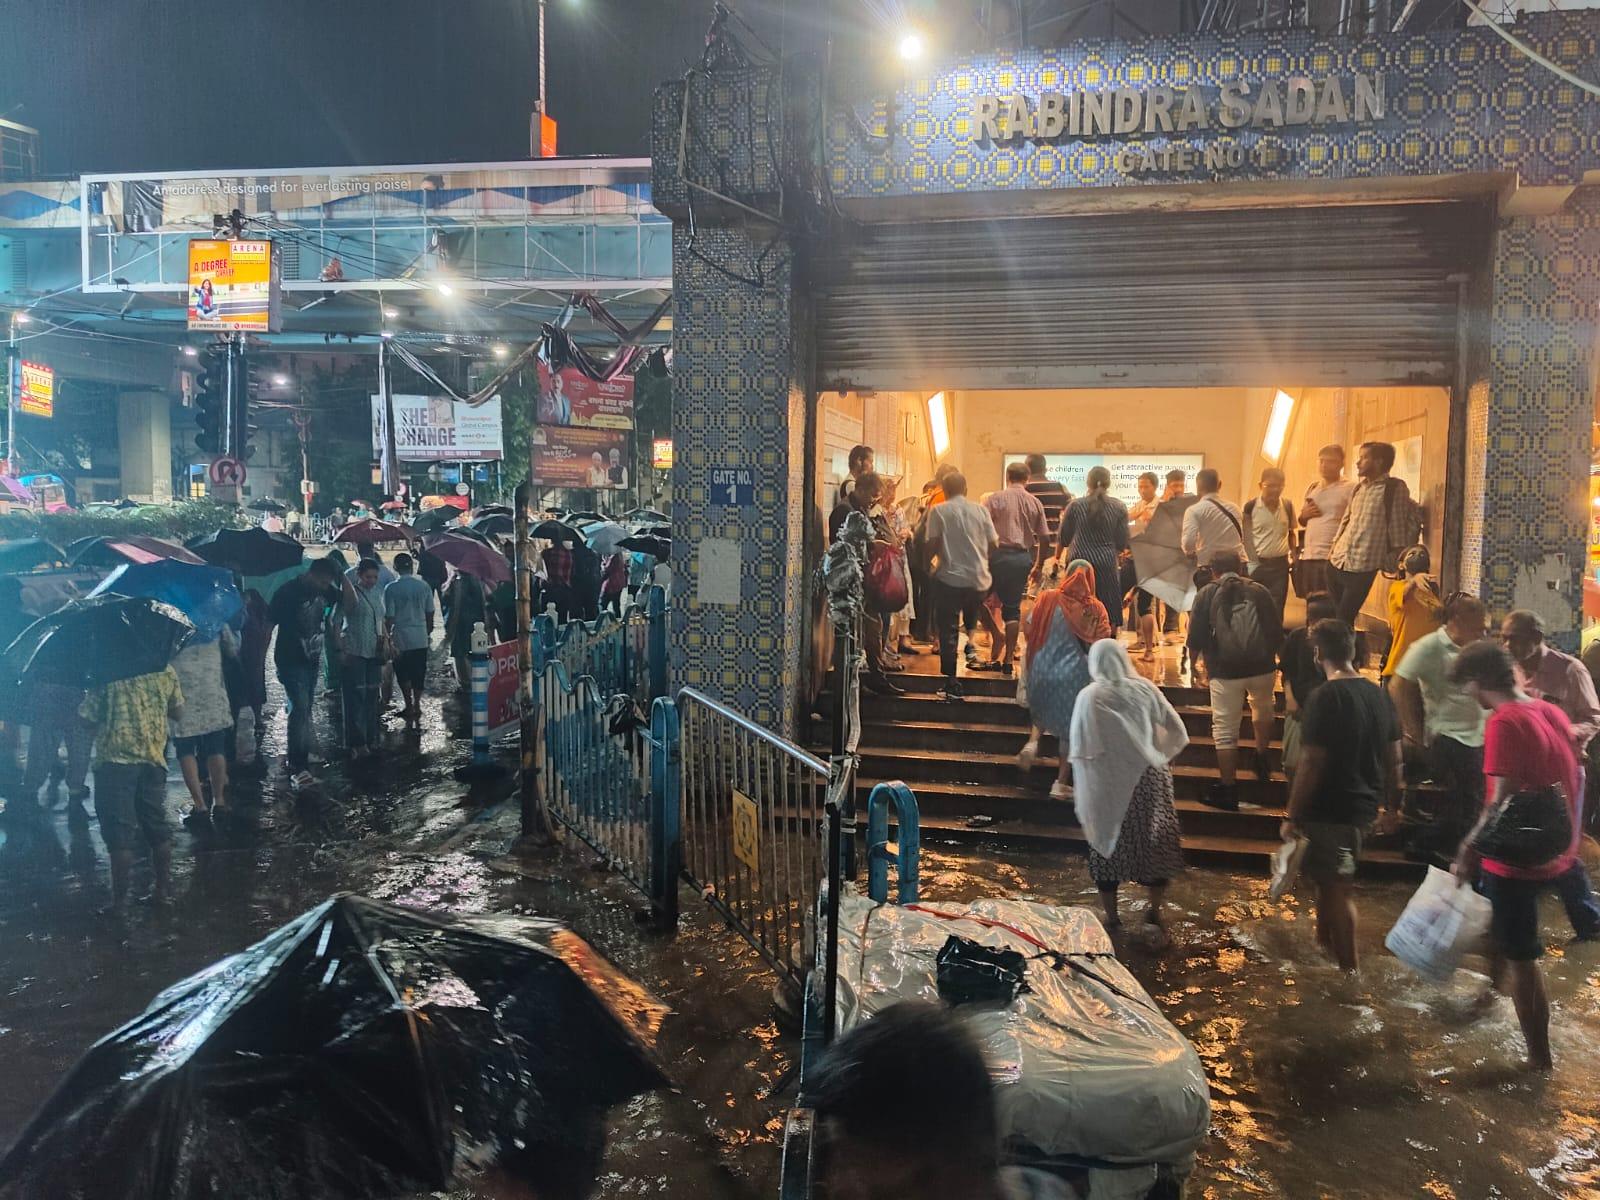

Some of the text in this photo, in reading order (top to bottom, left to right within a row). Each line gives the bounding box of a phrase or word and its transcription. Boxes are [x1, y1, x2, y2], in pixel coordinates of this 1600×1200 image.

[973, 73, 1386, 141] RABINDRA SADAN
[1117, 148, 1195, 173] GATE
[1206, 145, 1245, 170] NO
[152, 179, 409, 196] An address designed for everlasting poise
[233, 244, 265, 252] ARENA
[201, 259, 228, 272] DEGREE
[396, 427, 457, 446] CHANGE
[1055, 464, 1084, 473] children
[713, 470, 752, 485] GATE NO.
[726, 485, 737, 504] 1
